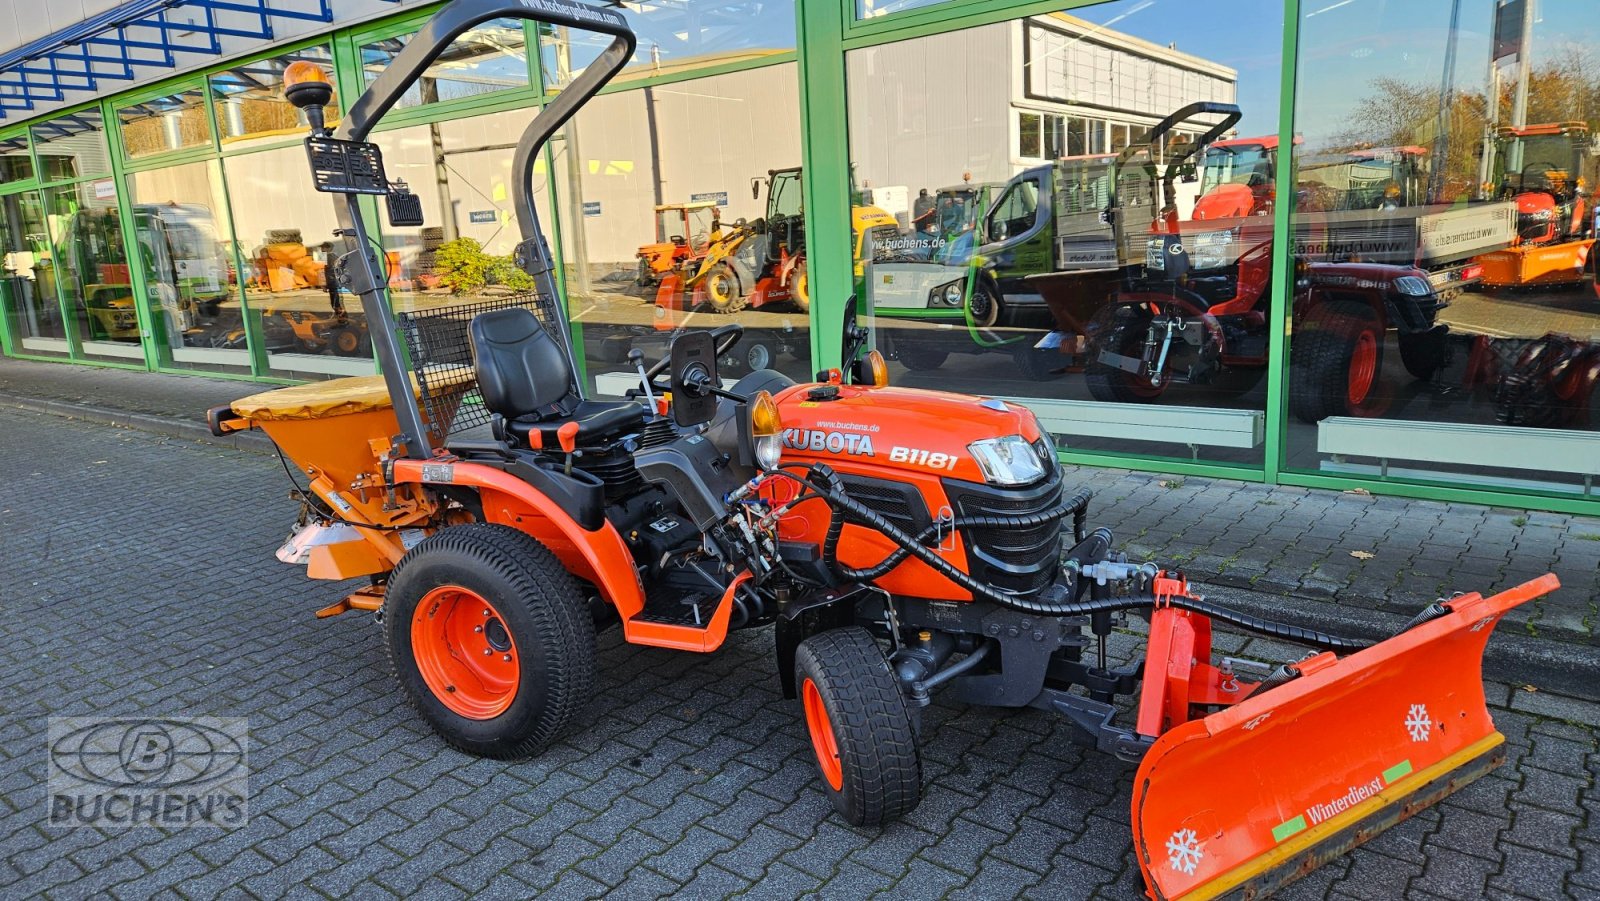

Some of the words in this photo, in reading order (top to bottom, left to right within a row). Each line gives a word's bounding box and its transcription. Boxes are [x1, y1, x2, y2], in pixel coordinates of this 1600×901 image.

[816, 421, 880, 433] www.buchens.de
[889, 446, 958, 471] B1181
[1306, 776, 1384, 825] Winterdienst
